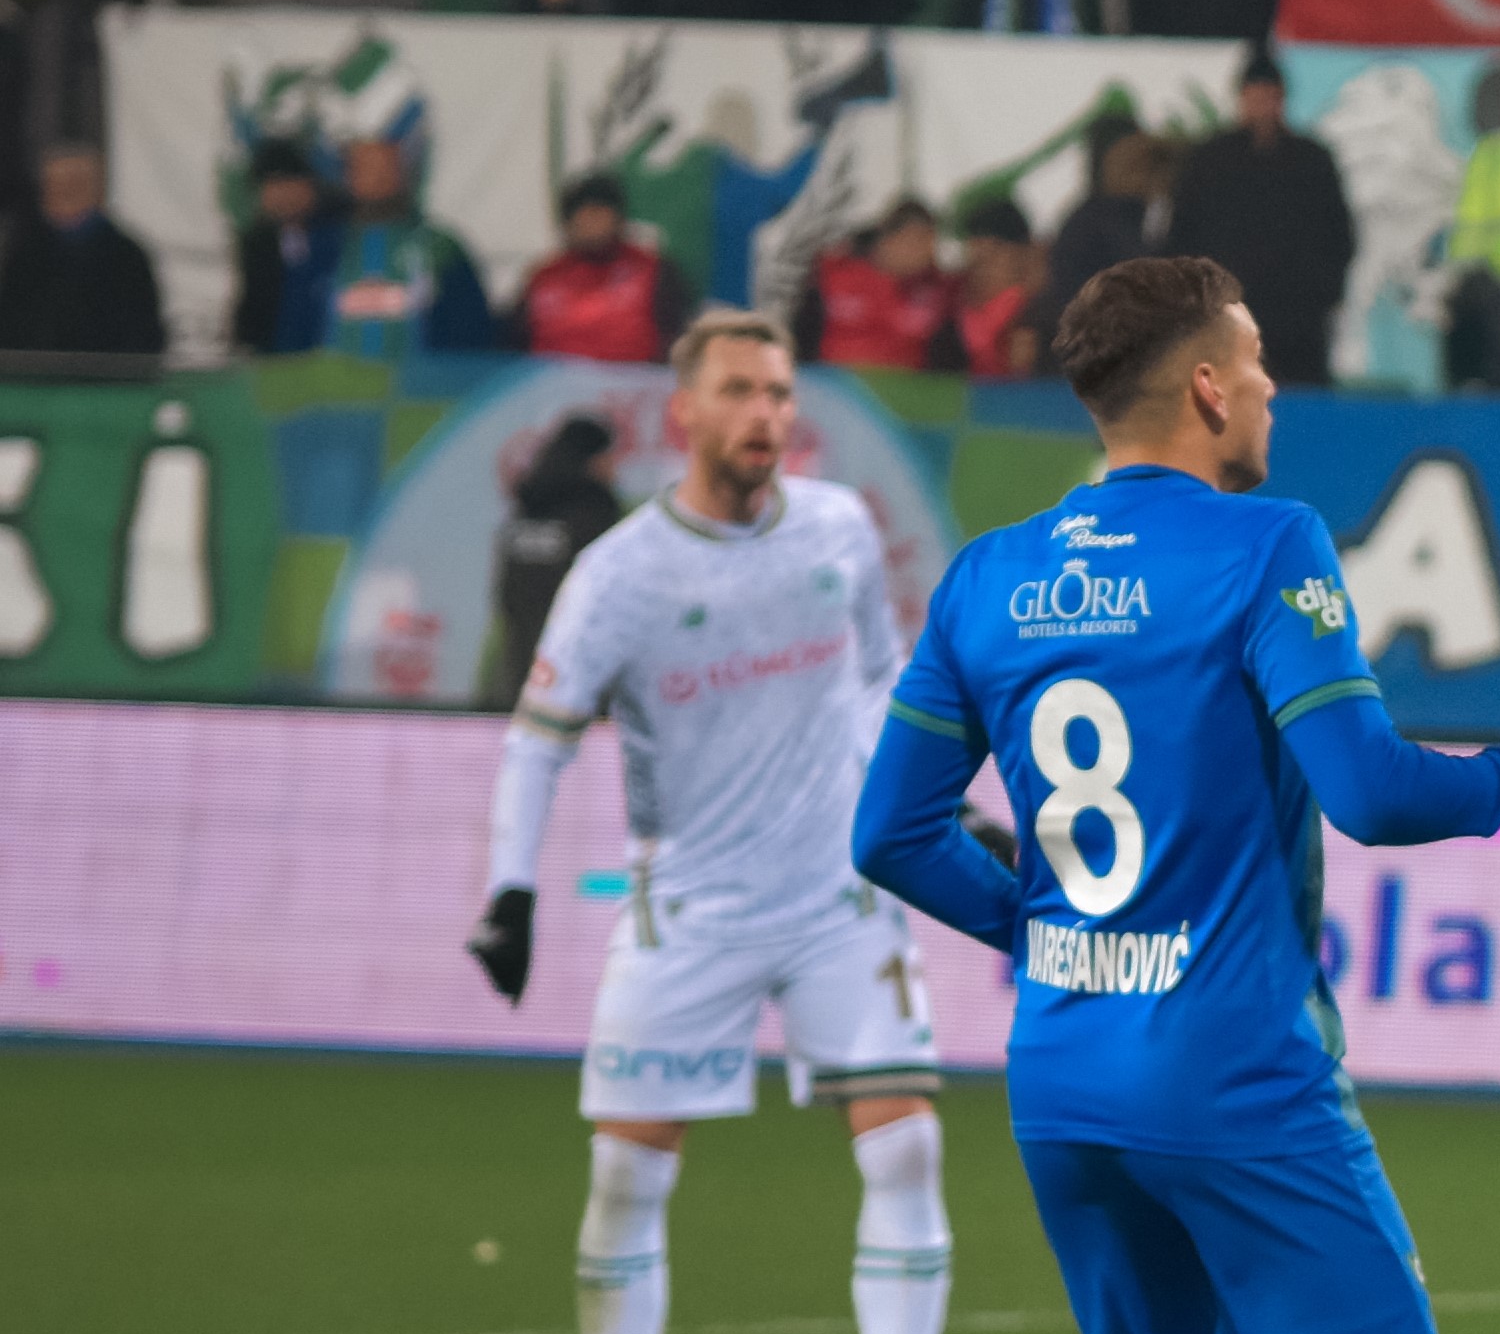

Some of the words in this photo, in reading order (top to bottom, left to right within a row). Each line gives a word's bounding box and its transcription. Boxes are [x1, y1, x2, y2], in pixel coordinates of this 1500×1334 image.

[1010, 567, 1152, 622] GLORIA
[1018, 622, 1066, 640] HOTELS
[1067, 622, 1078, 635] &
[1080, 619, 1138, 635] RESORTS
[1030, 677, 1146, 917] 8
